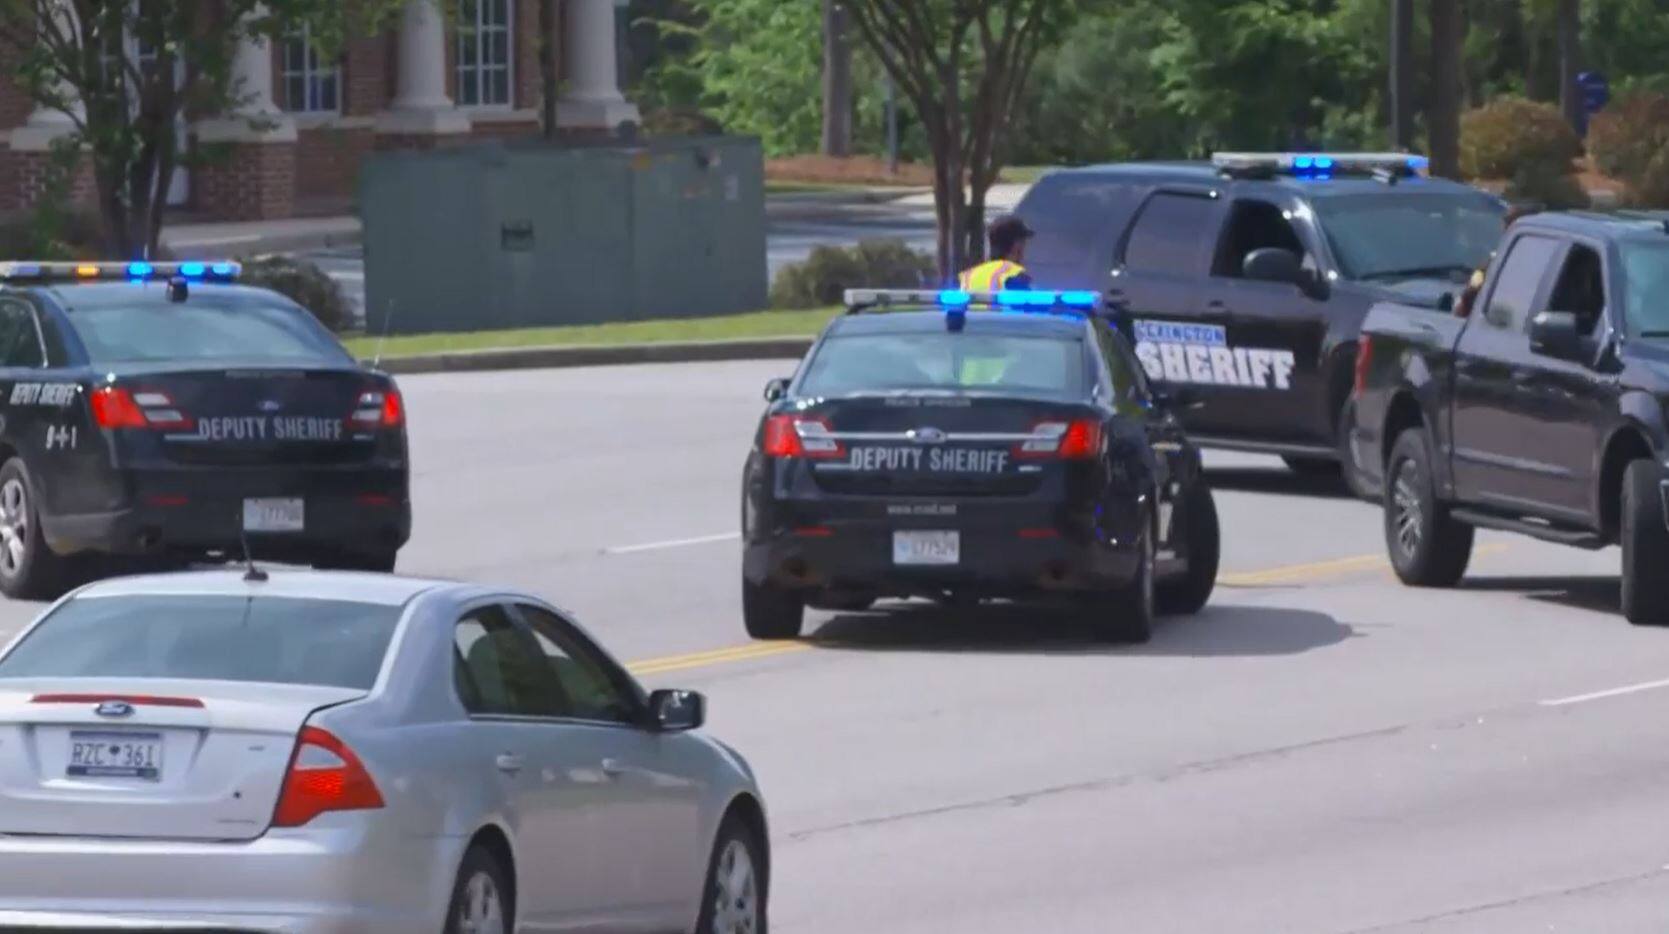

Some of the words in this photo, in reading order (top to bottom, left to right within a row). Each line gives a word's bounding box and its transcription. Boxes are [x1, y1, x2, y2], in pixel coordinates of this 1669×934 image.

[1135, 341, 1296, 390] SHERIFF
[199, 416, 267, 440] DEPUTY
[273, 417, 342, 440] SHERIFF
[850, 447, 924, 471] DEPUTY
[930, 448, 1009, 473] SHERIFF
